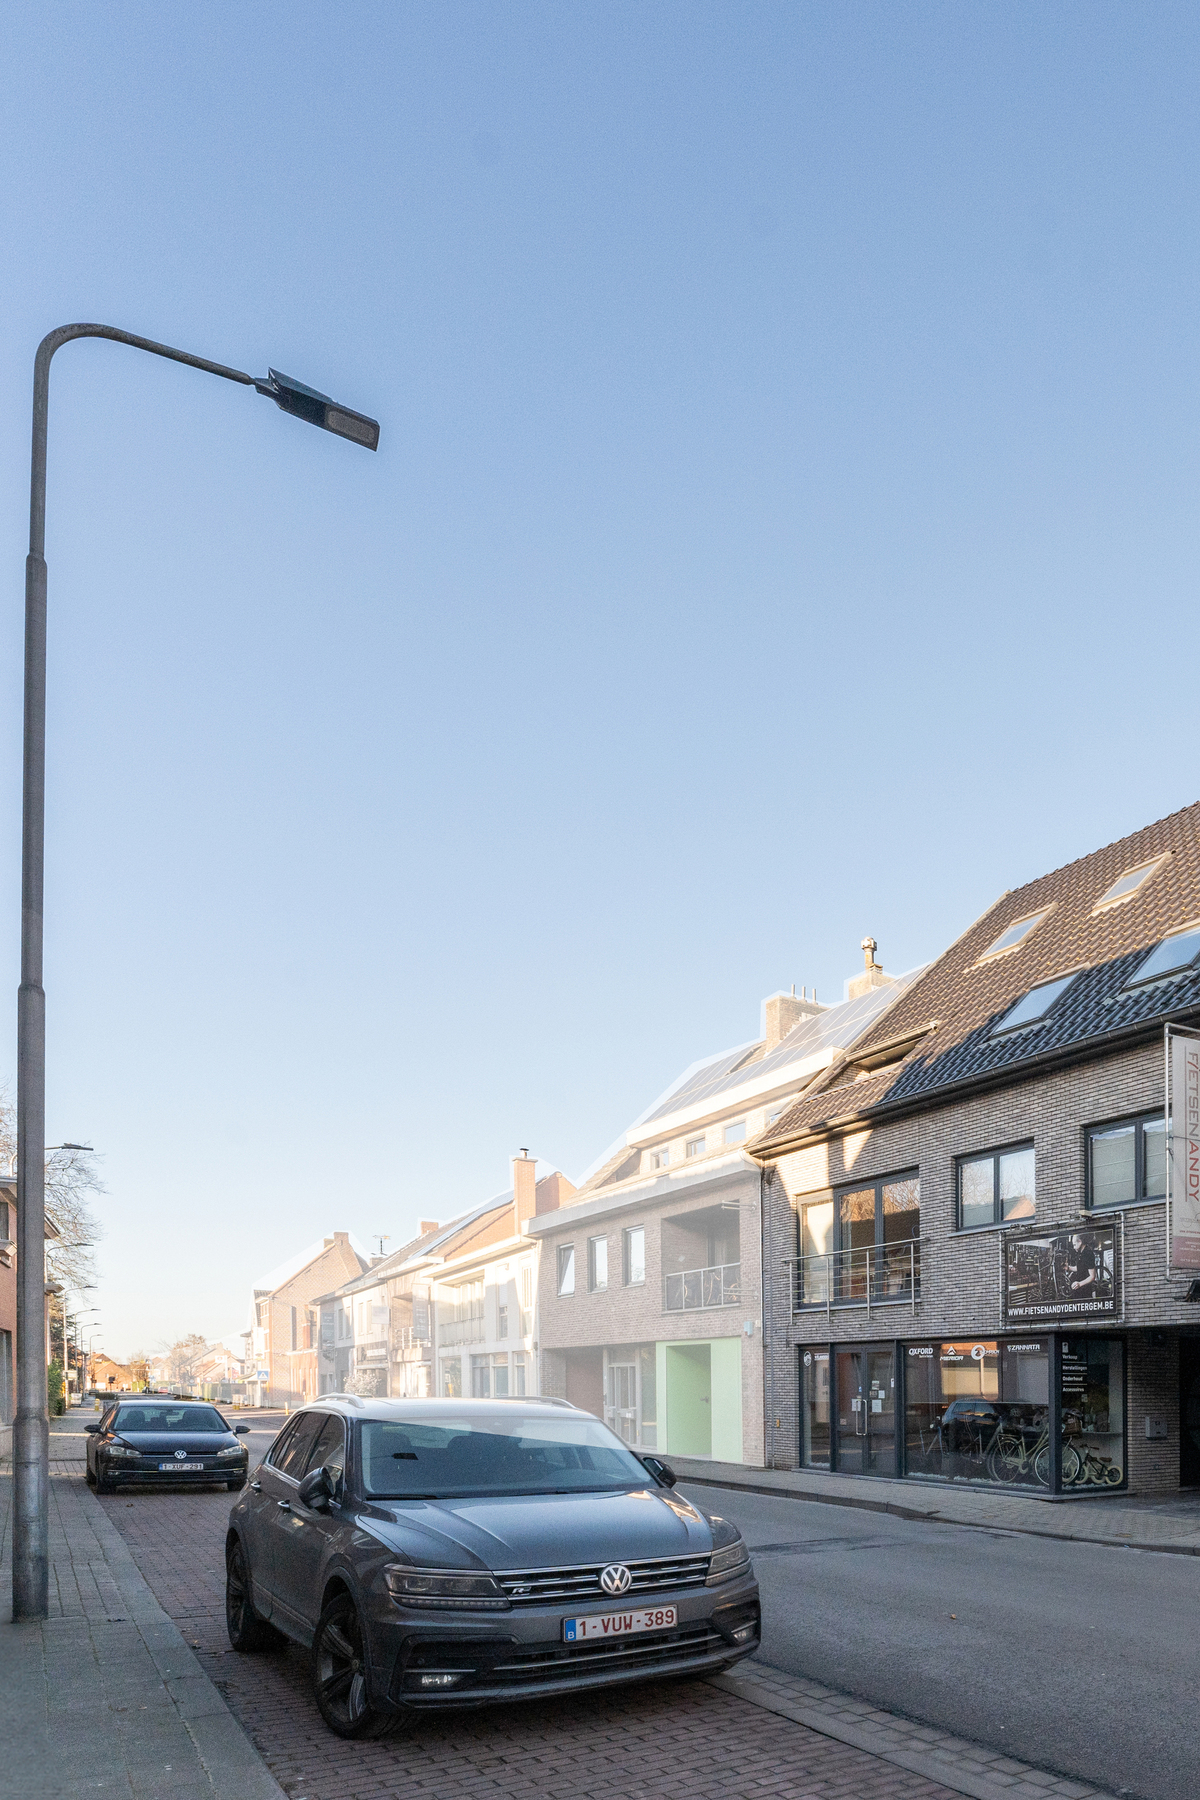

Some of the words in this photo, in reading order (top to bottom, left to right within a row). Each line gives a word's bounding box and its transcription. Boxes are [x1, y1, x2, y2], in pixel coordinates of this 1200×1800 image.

[1008, 1300, 1114, 1317] WWW.FIETSENANDYDENTERGEM.BE
[908, 1347, 934, 1356] OXFORD
[567, 1631, 575, 1639] B
[579, 1609, 674, 1637] 1-VUW-389
